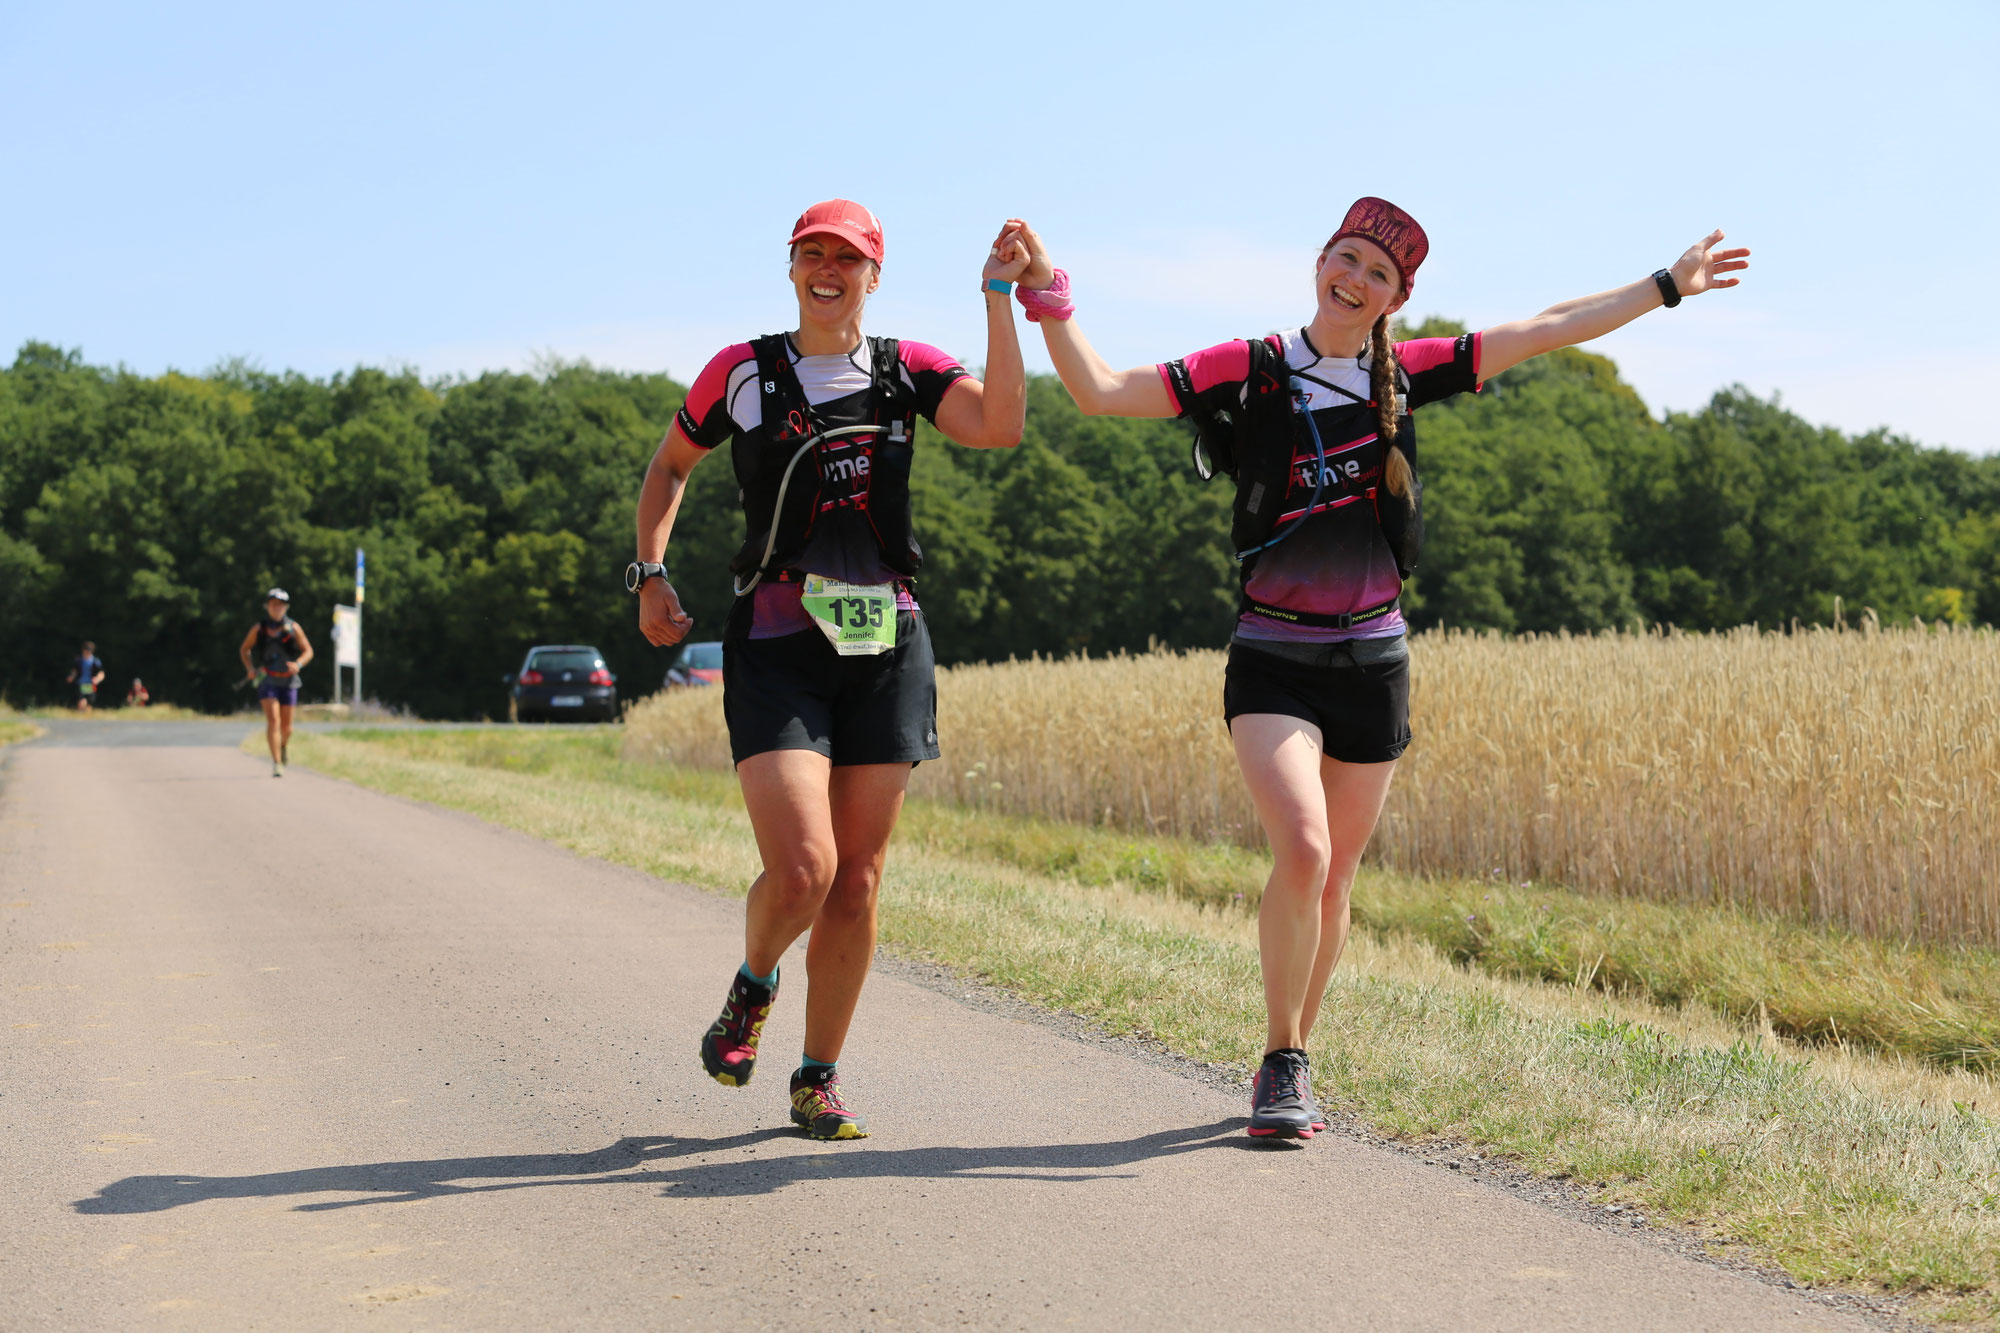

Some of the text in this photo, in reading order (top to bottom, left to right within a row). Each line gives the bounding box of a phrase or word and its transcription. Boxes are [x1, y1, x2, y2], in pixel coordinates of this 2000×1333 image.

[829, 598, 883, 628] 135
[1254, 605, 1290, 619] NATHAN
[1352, 608, 1382, 622] NATHAN
[844, 632, 875, 640] Jennifer
